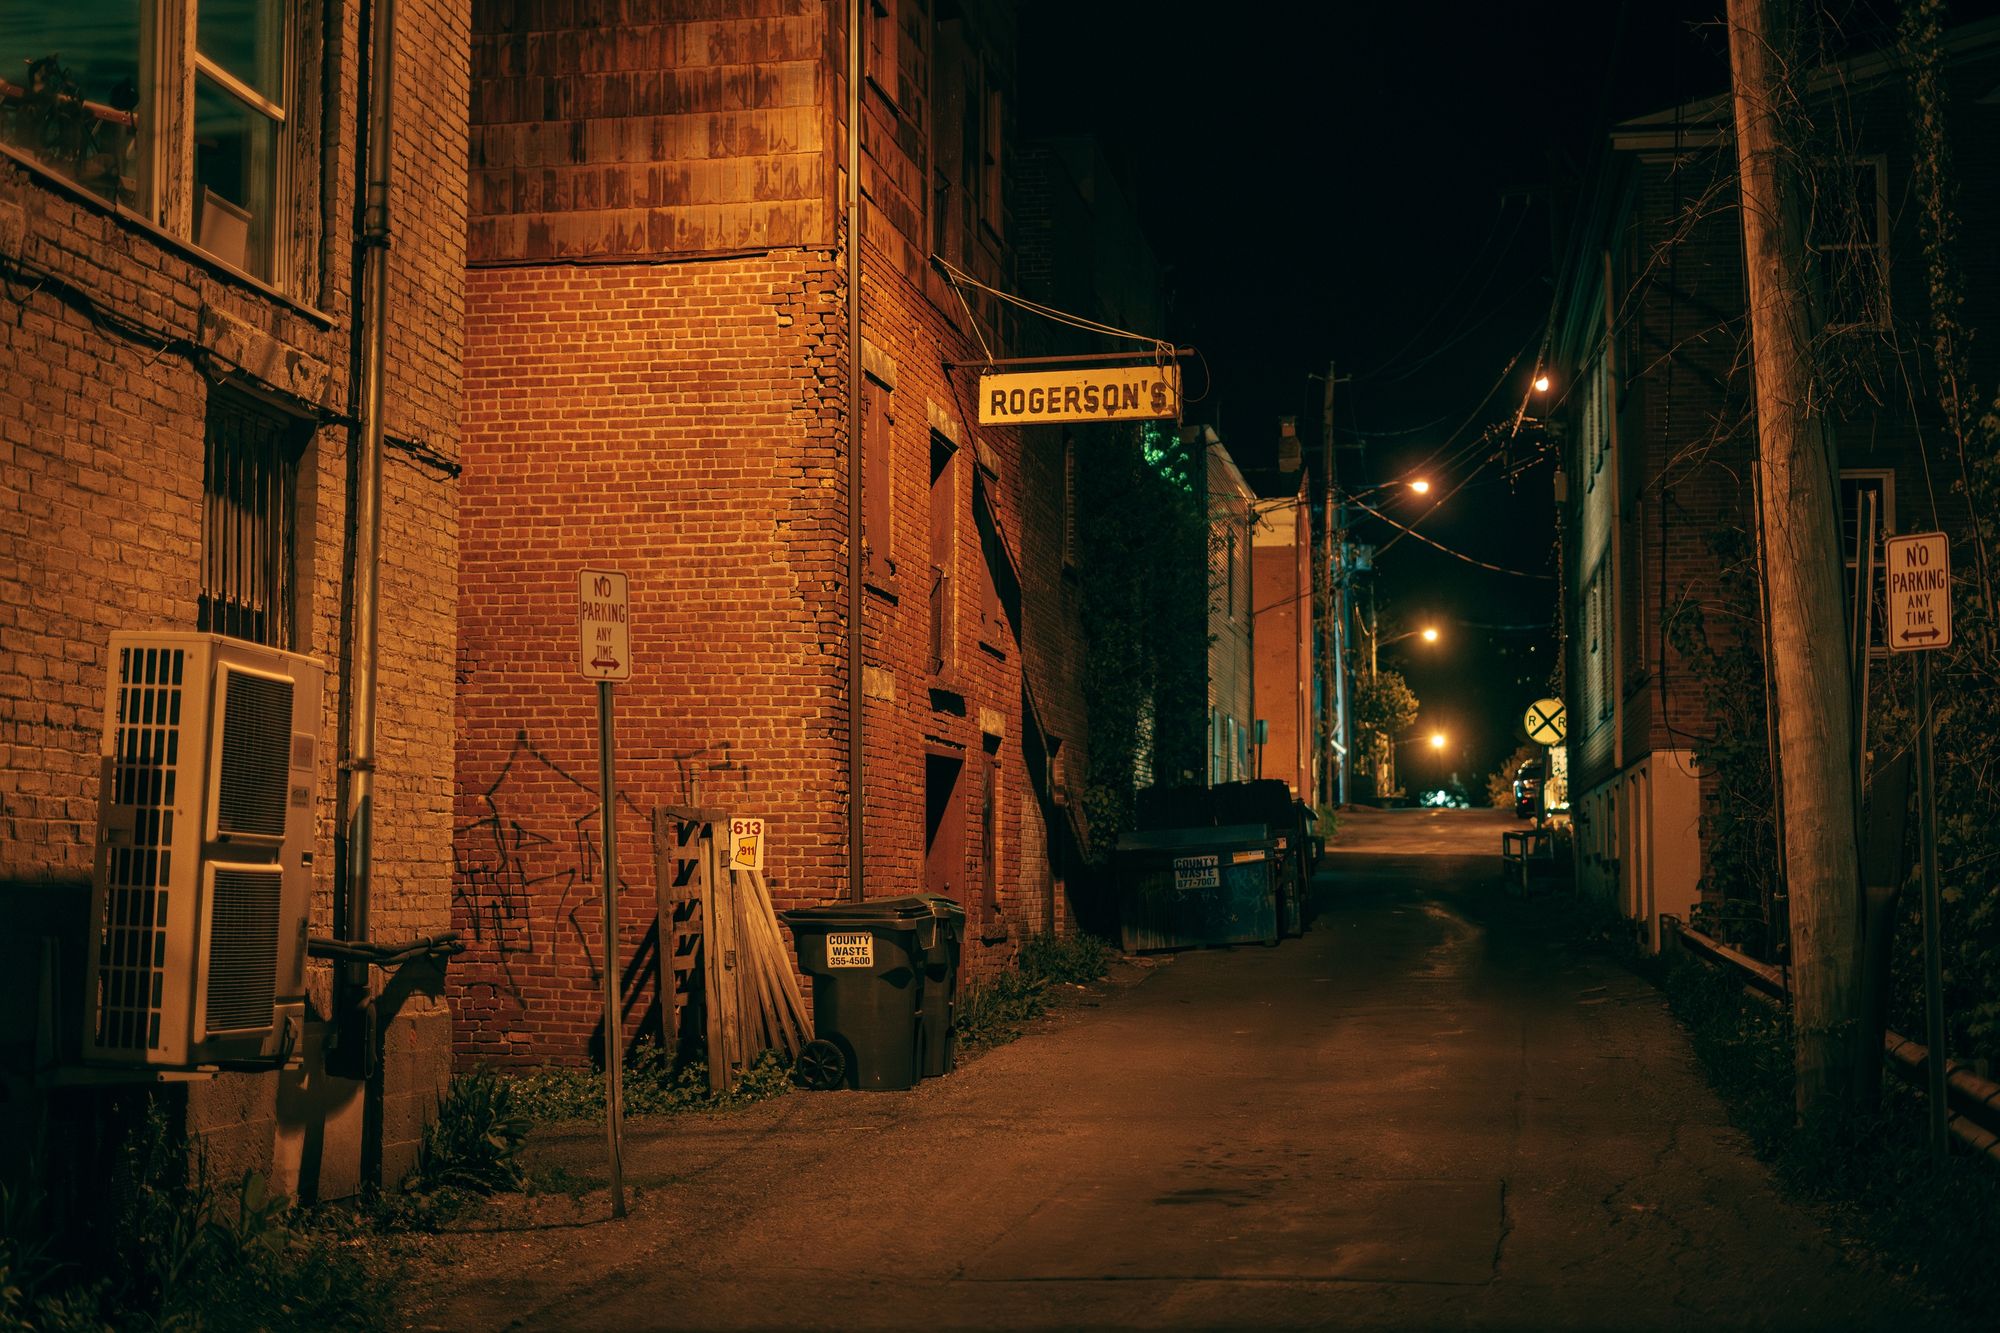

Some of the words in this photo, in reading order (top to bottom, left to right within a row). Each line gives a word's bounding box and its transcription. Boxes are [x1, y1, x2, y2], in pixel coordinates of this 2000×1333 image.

[1906, 545, 1929, 568] NO
[594, 578, 611, 597] NO
[1892, 569, 1945, 593] PARKING
[1907, 593, 1931, 609] ANY
[582, 601, 625, 623] PARKING
[1905, 610, 1934, 626] TIME
[596, 627, 612, 642] ANY
[596, 645, 613, 661] TIME
[1528, 715, 1536, 726] R
[1558, 717, 1567, 728] R
[733, 821, 761, 835] 613
[741, 846, 755, 856] 911
[1175, 858, 1215, 869] COUNTY
[1179, 867, 1213, 878] WASTE
[829, 935, 871, 945] COUNTY
[832, 946, 869, 956] WASTE
[830, 956, 871, 966] 355-4500
